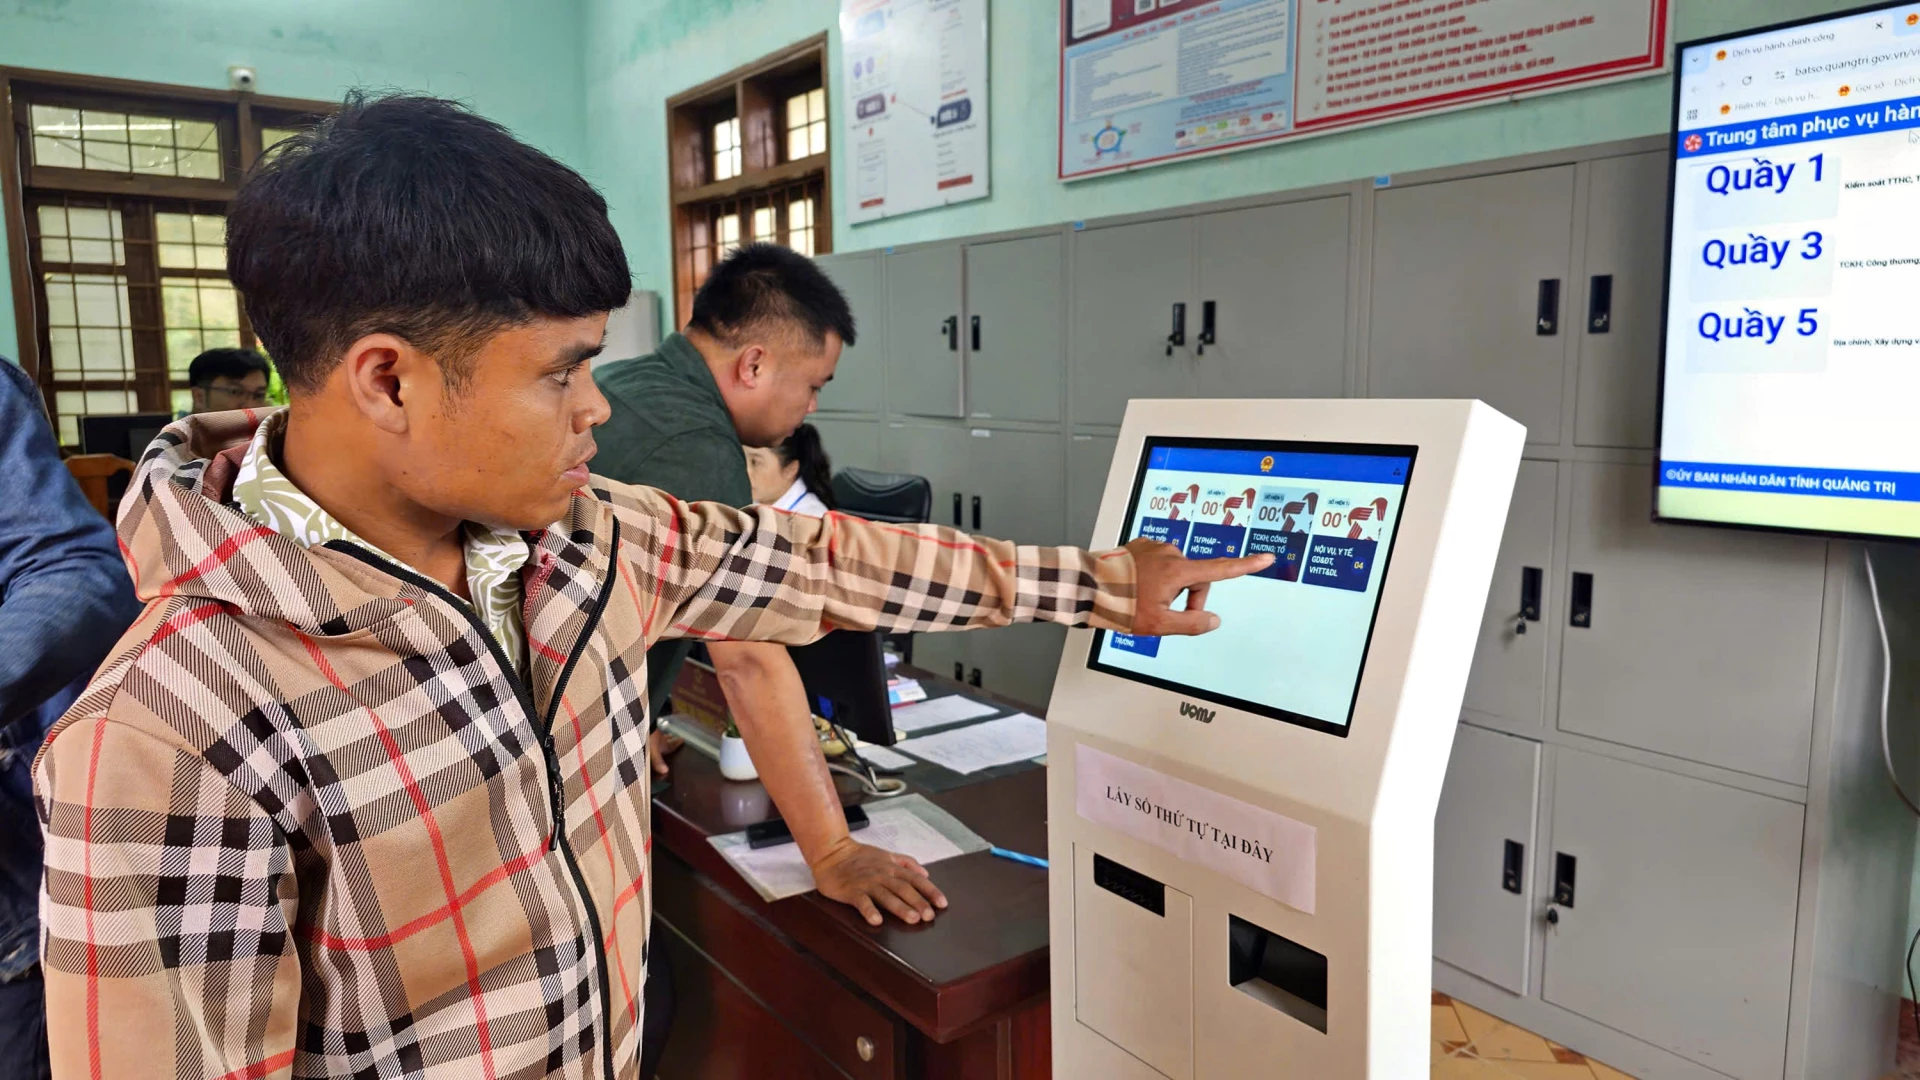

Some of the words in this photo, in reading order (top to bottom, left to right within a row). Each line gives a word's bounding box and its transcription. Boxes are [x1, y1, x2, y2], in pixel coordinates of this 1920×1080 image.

[1705, 127, 1757, 148] Trung
[1762, 118, 1798, 140] tâm
[1802, 114, 1850, 137] phục
[1855, 111, 1879, 129] vụ
[1706, 157, 1796, 194] Quầy
[1808, 153, 1824, 182] 1
[1702, 233, 1790, 270] Quầy
[1801, 231, 1823, 260] 3
[1699, 307, 1785, 344] Quầy
[1796, 308, 1818, 336] 5
[1694, 470, 1720, 483] BAN
[1721, 470, 1757, 485] NHÂN
[1759, 471, 1788, 487] DÂN
[1822, 477, 1870, 493] QUẢNG
[1873, 481, 1896, 496] TRỊ
[1226, 545, 1235, 553] 02
[1270, 535, 1288, 544] CÔNG
[1313, 545, 1326, 554] NỘI
[1338, 547, 1344, 556] Y
[1287, 553, 1296, 561] 03
[1353, 561, 1364, 570] 04
[1154, 804, 1185, 827] THỨ
[1186, 817, 1209, 840] TỰ
[1211, 827, 1236, 850] TẠI
[1241, 838, 1273, 863] ĐÂY
